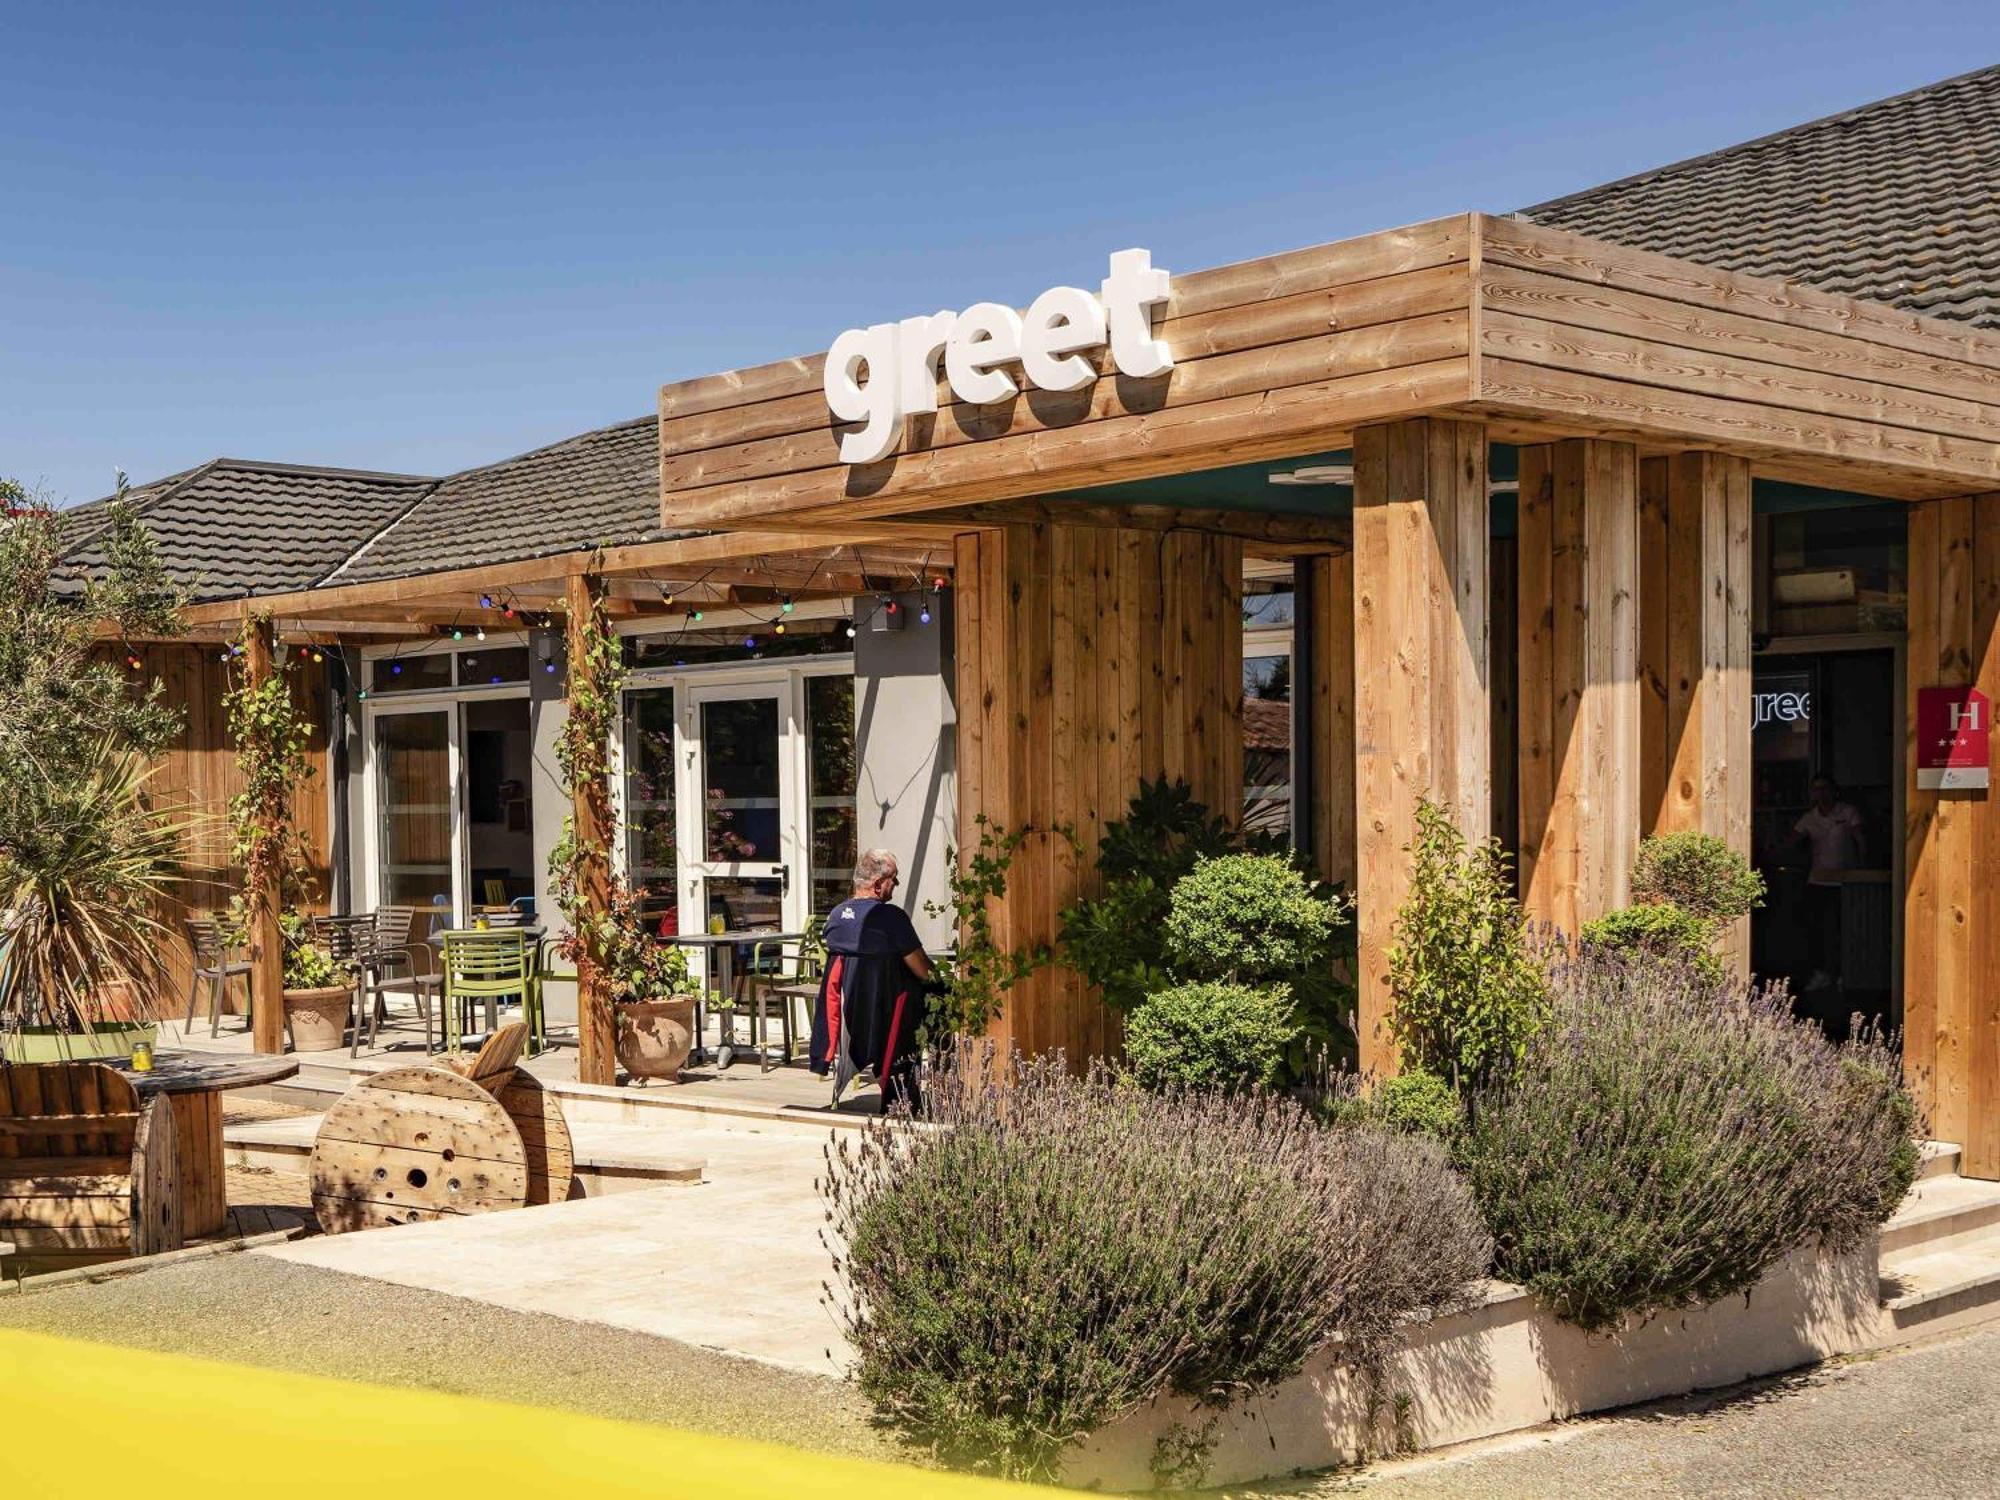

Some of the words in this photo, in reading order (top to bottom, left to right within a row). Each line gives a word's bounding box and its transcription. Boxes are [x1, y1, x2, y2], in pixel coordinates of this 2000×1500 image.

[824, 247, 1174, 464] greet
[1751, 692, 1810, 730] re
[1947, 702, 1981, 731] H
